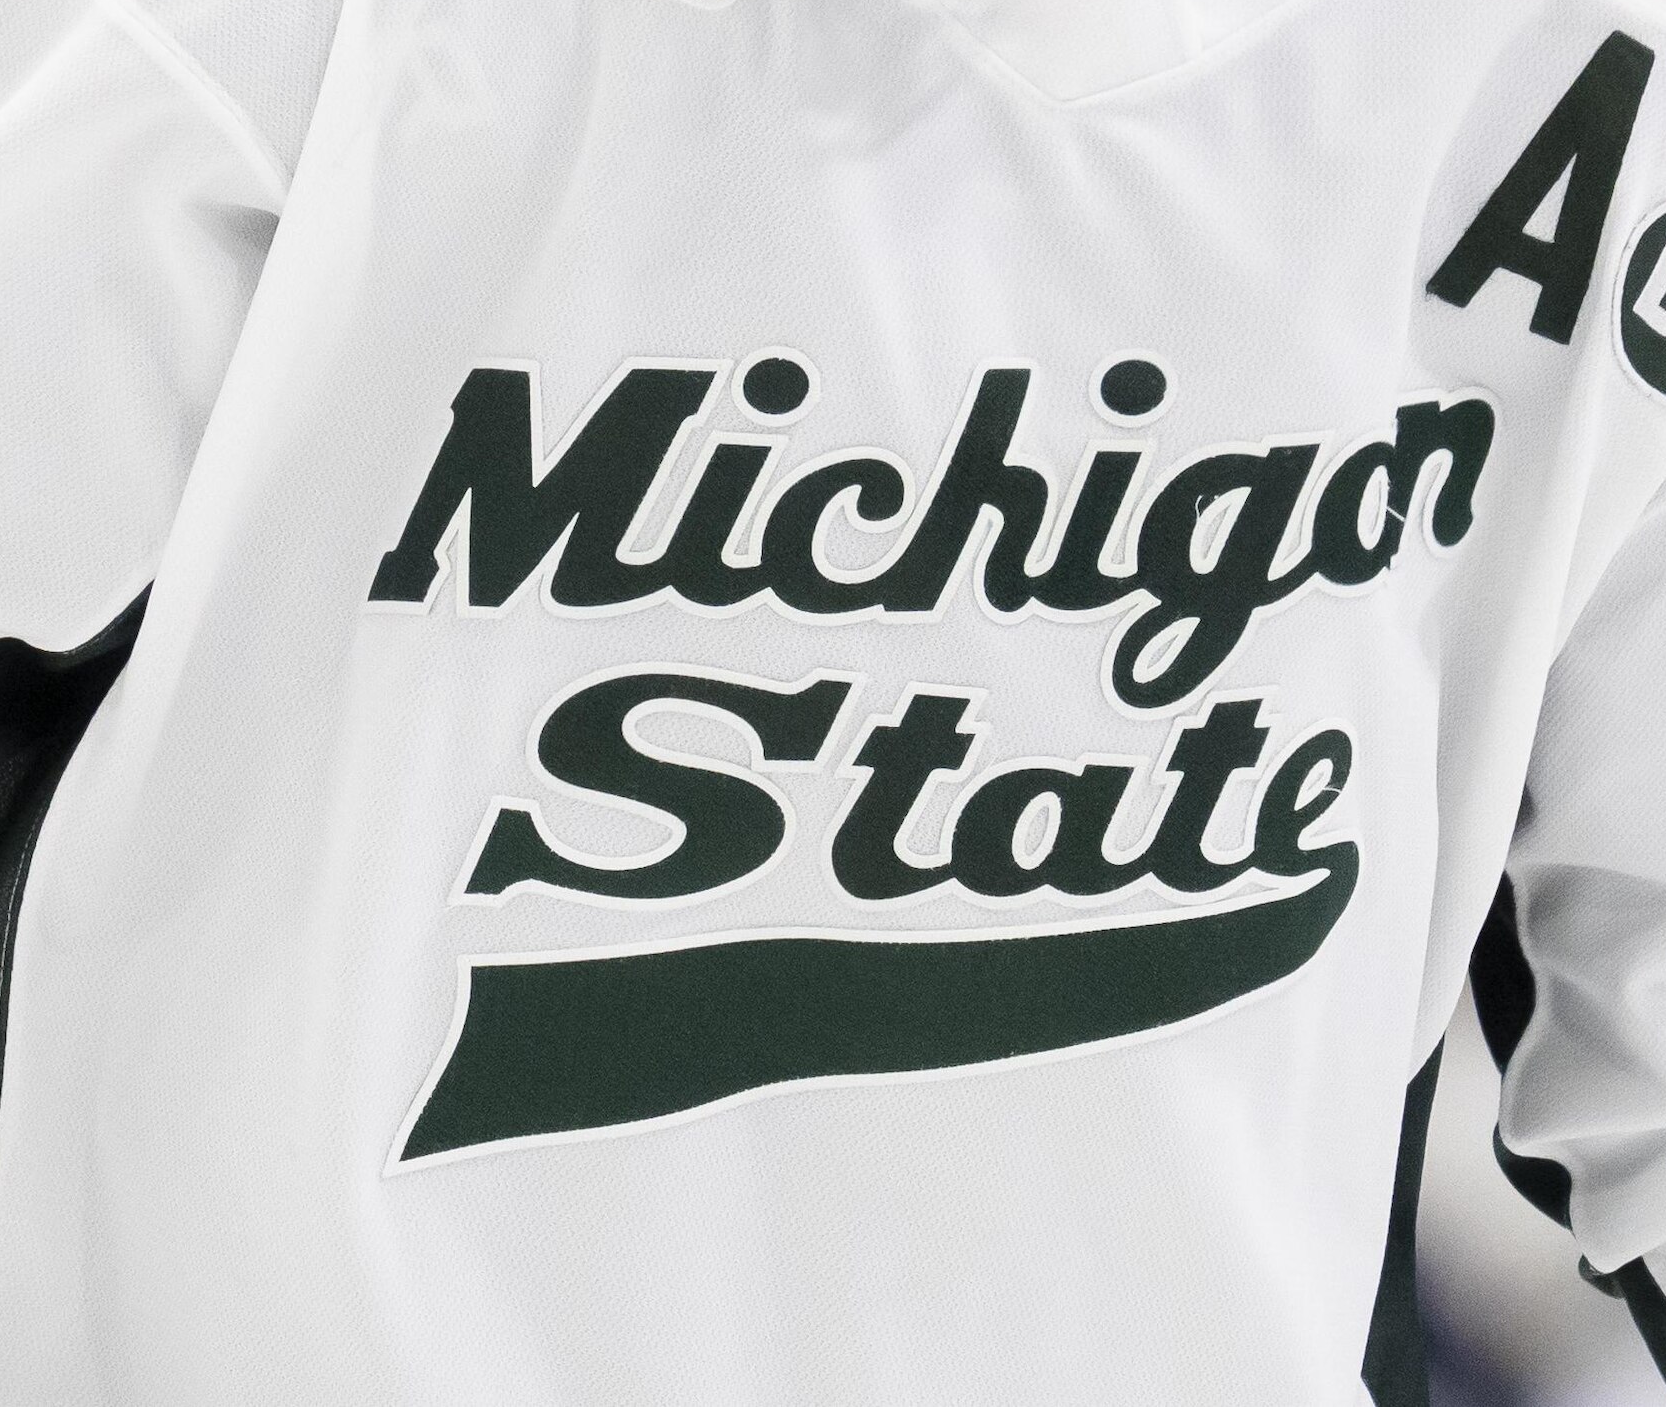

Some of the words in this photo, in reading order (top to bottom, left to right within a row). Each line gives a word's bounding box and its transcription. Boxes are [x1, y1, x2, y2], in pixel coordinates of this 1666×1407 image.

[1425, 30, 1655, 346] A
[367, 357, 1495, 710] Michigan
[464, 672, 1357, 904] State
